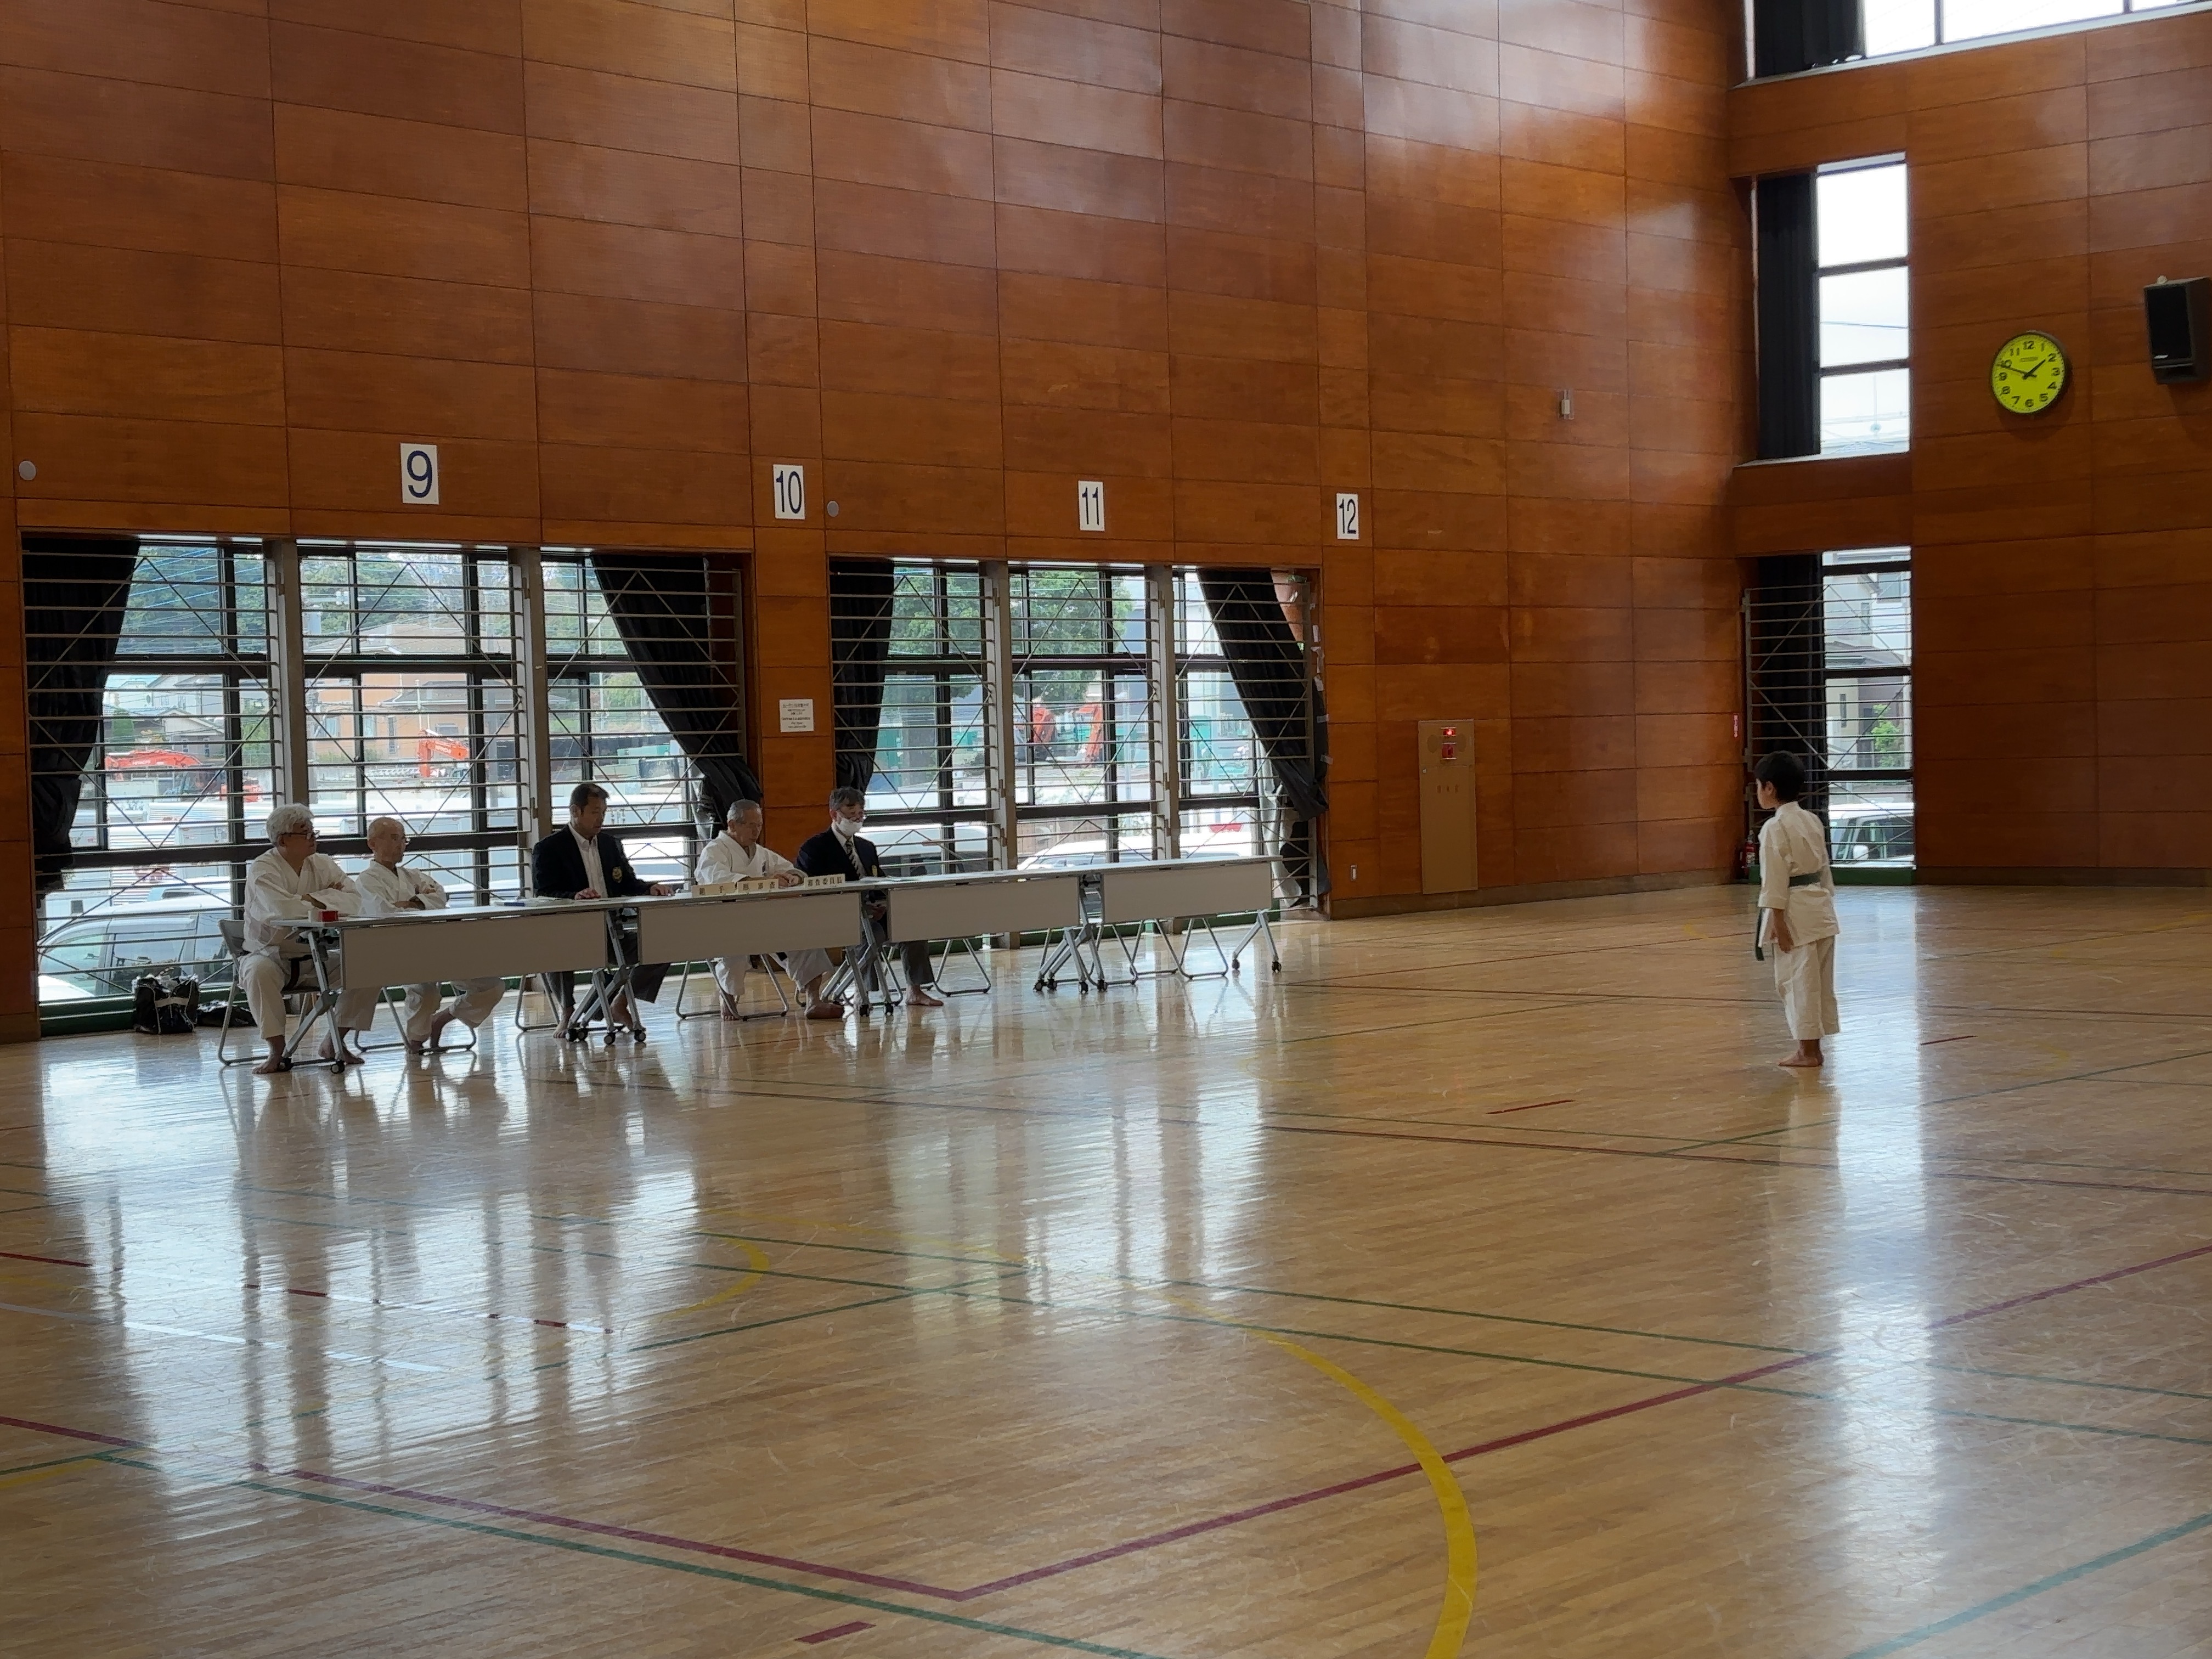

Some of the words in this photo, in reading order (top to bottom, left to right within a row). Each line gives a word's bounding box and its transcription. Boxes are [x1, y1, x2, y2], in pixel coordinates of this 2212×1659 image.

[2023, 341, 2034, 349] 12
[2040, 343, 2045, 352] 1
[2010, 348, 2020, 356] 11
[2047, 353, 2056, 362] 2
[1999, 372, 2007, 381] 9
[2052, 368, 2060, 376] 3
[2002, 386, 2010, 394] 8
[2011, 396, 2021, 404] 7
[2039, 393, 2048, 402] 5
[2025, 399, 2034, 407] 6
[407, 450, 432, 498] 9
[776, 470, 802, 514] 10
[1082, 486, 1099, 526] 11
[1339, 498, 1356, 534] 12
